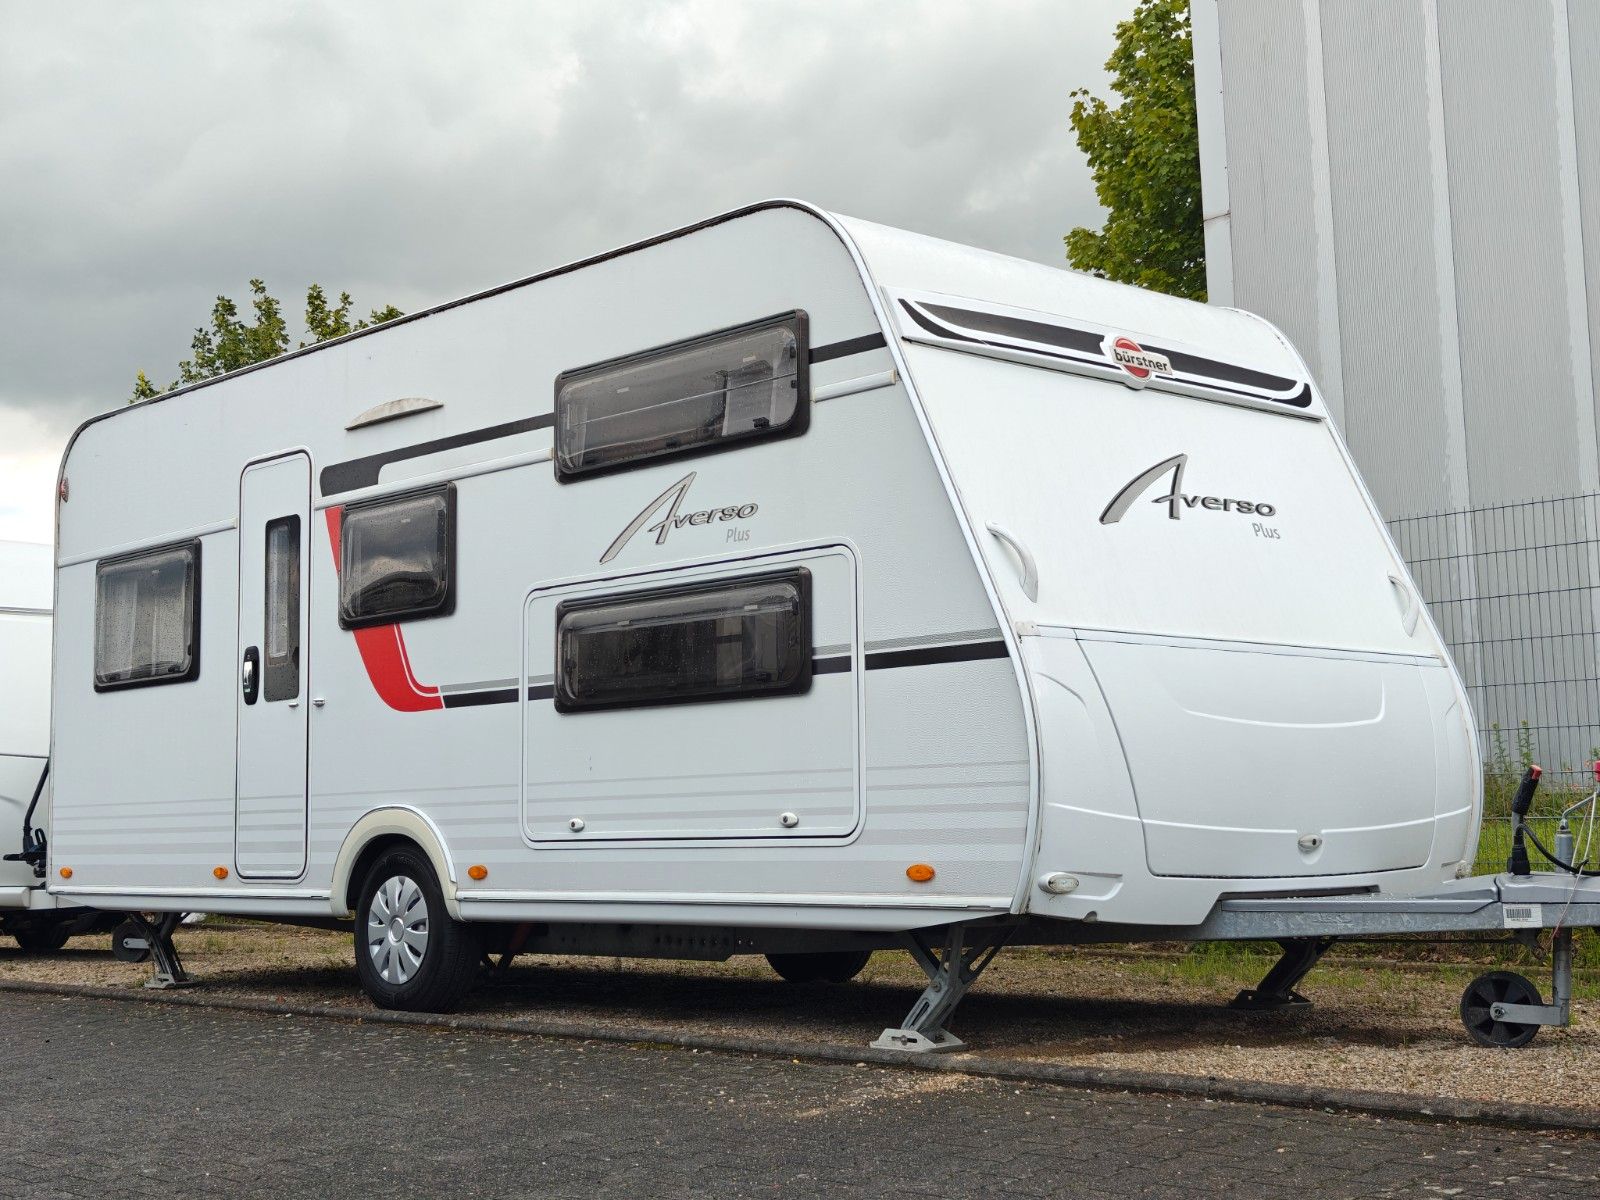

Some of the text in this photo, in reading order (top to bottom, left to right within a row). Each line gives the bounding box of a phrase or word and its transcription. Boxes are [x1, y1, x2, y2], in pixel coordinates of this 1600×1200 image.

[1113, 348, 1168, 371] bürstner
[1099, 453, 1276, 525] Averso
[600, 471, 759, 565] Averso
[726, 527, 751, 544] Plus
[1251, 522, 1281, 540] Plus
